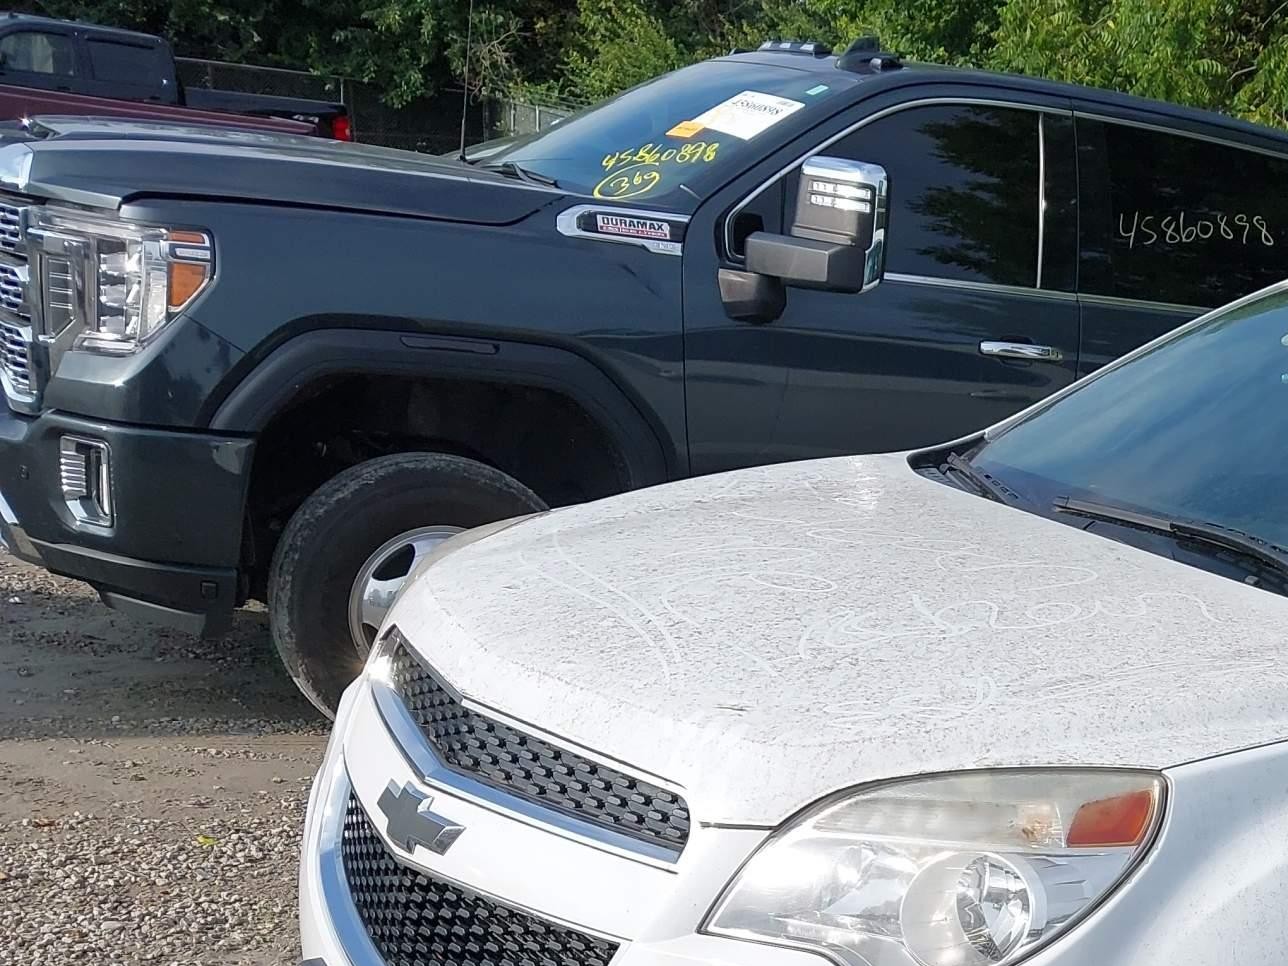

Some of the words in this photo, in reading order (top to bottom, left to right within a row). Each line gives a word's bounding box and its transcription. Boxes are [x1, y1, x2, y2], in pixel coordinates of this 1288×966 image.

[602, 142, 720, 171] 45860898
[610, 171, 659, 196] 369
[600, 215, 665, 232] DURAMAX
[1118, 210, 1275, 249] 45860898
